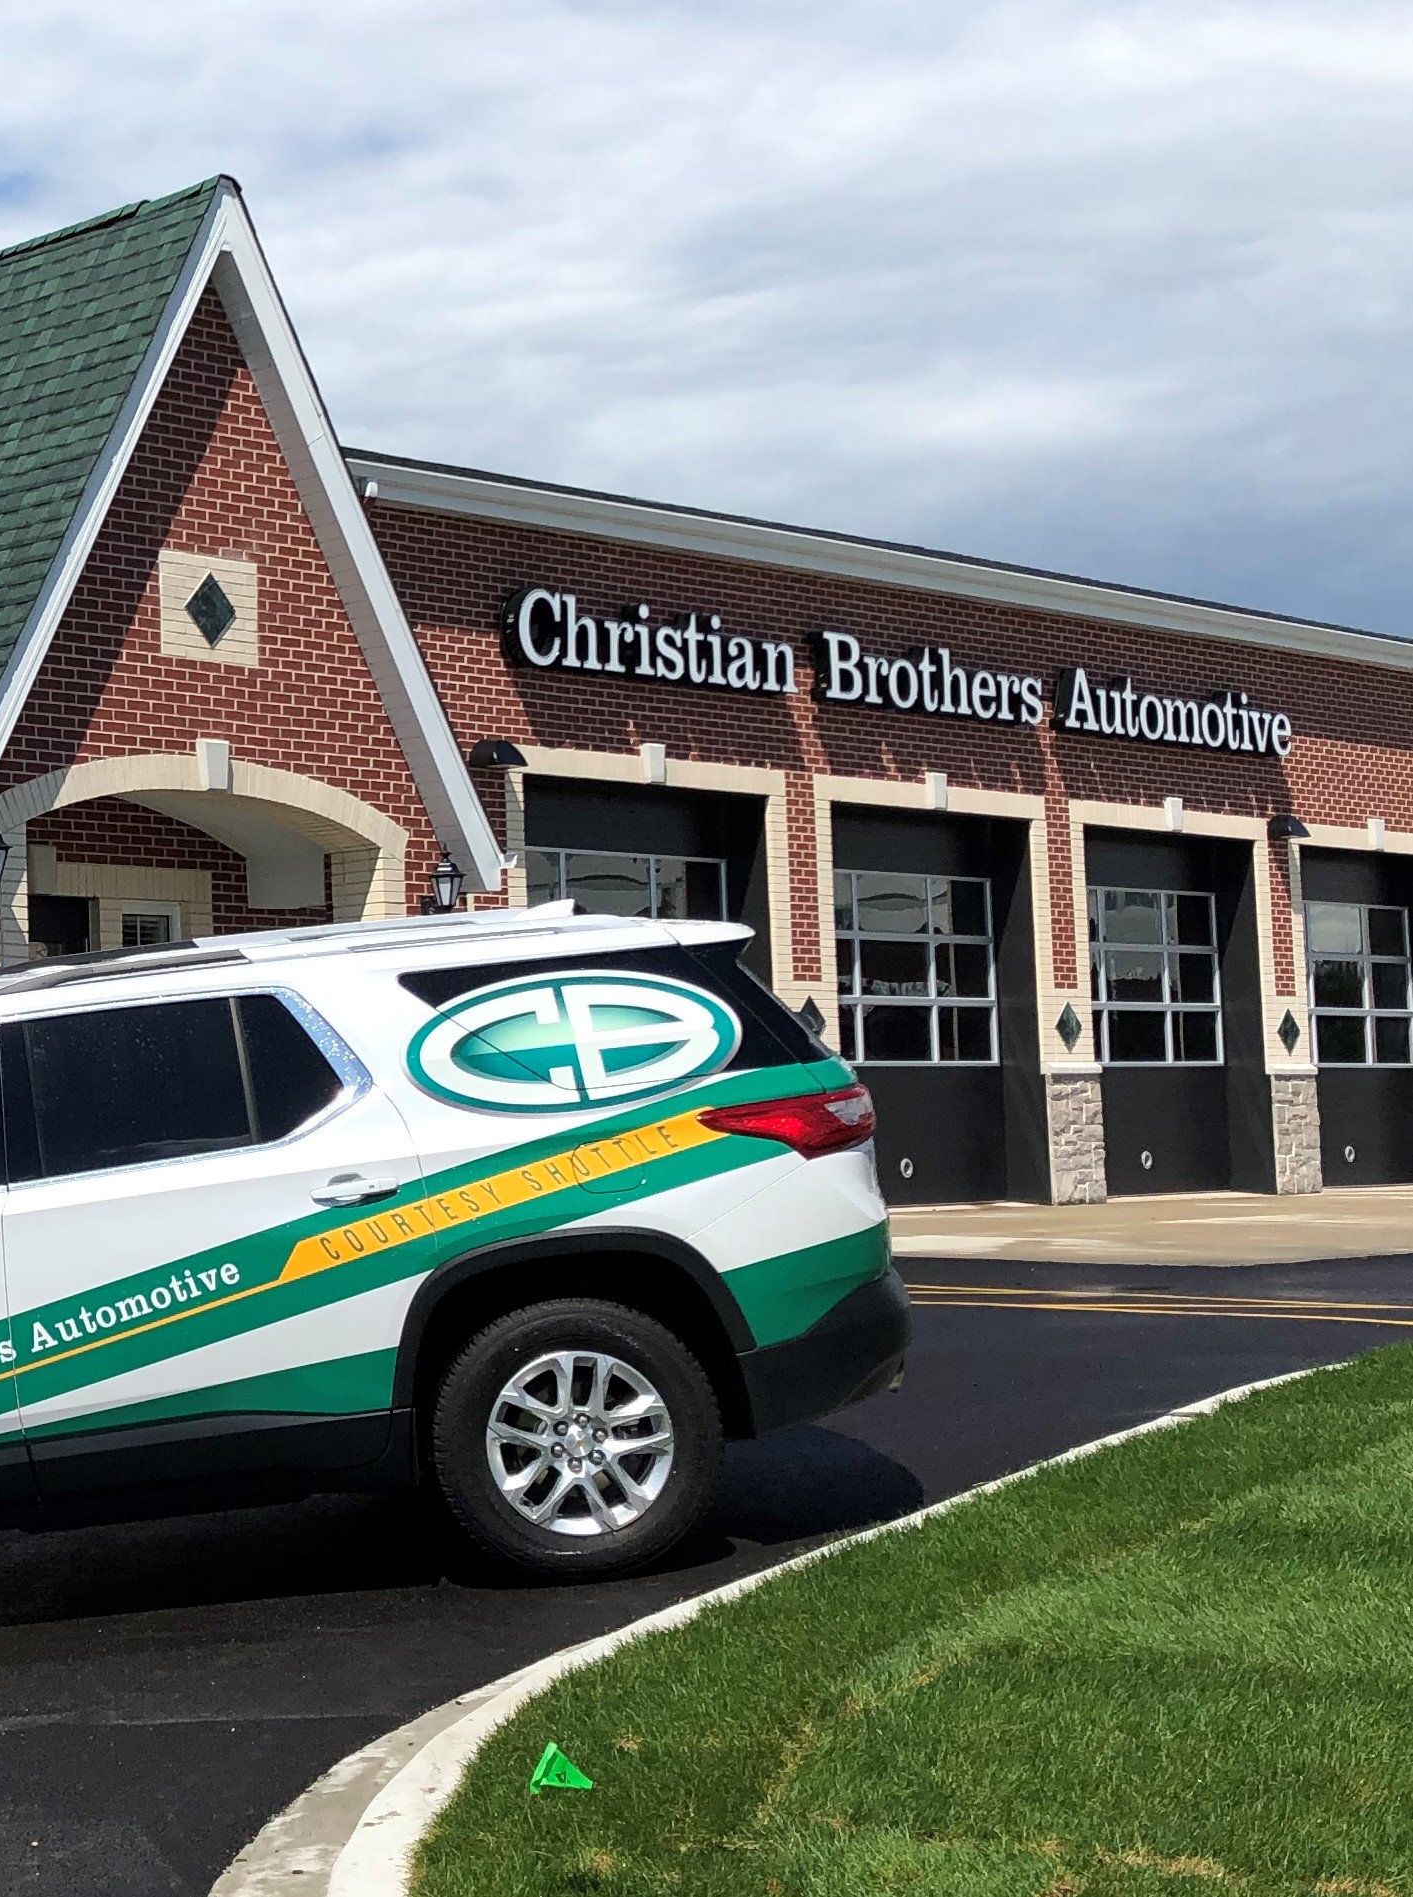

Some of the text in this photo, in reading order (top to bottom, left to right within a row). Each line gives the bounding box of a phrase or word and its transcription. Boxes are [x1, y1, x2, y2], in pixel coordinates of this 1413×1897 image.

[518, 587, 1292, 756] Christian Brothers Automotive
[418, 983, 721, 1106] CB
[319, 1125, 679, 1261] COURTESY SHUTTLE
[30, 1262, 241, 1353] Automotive
